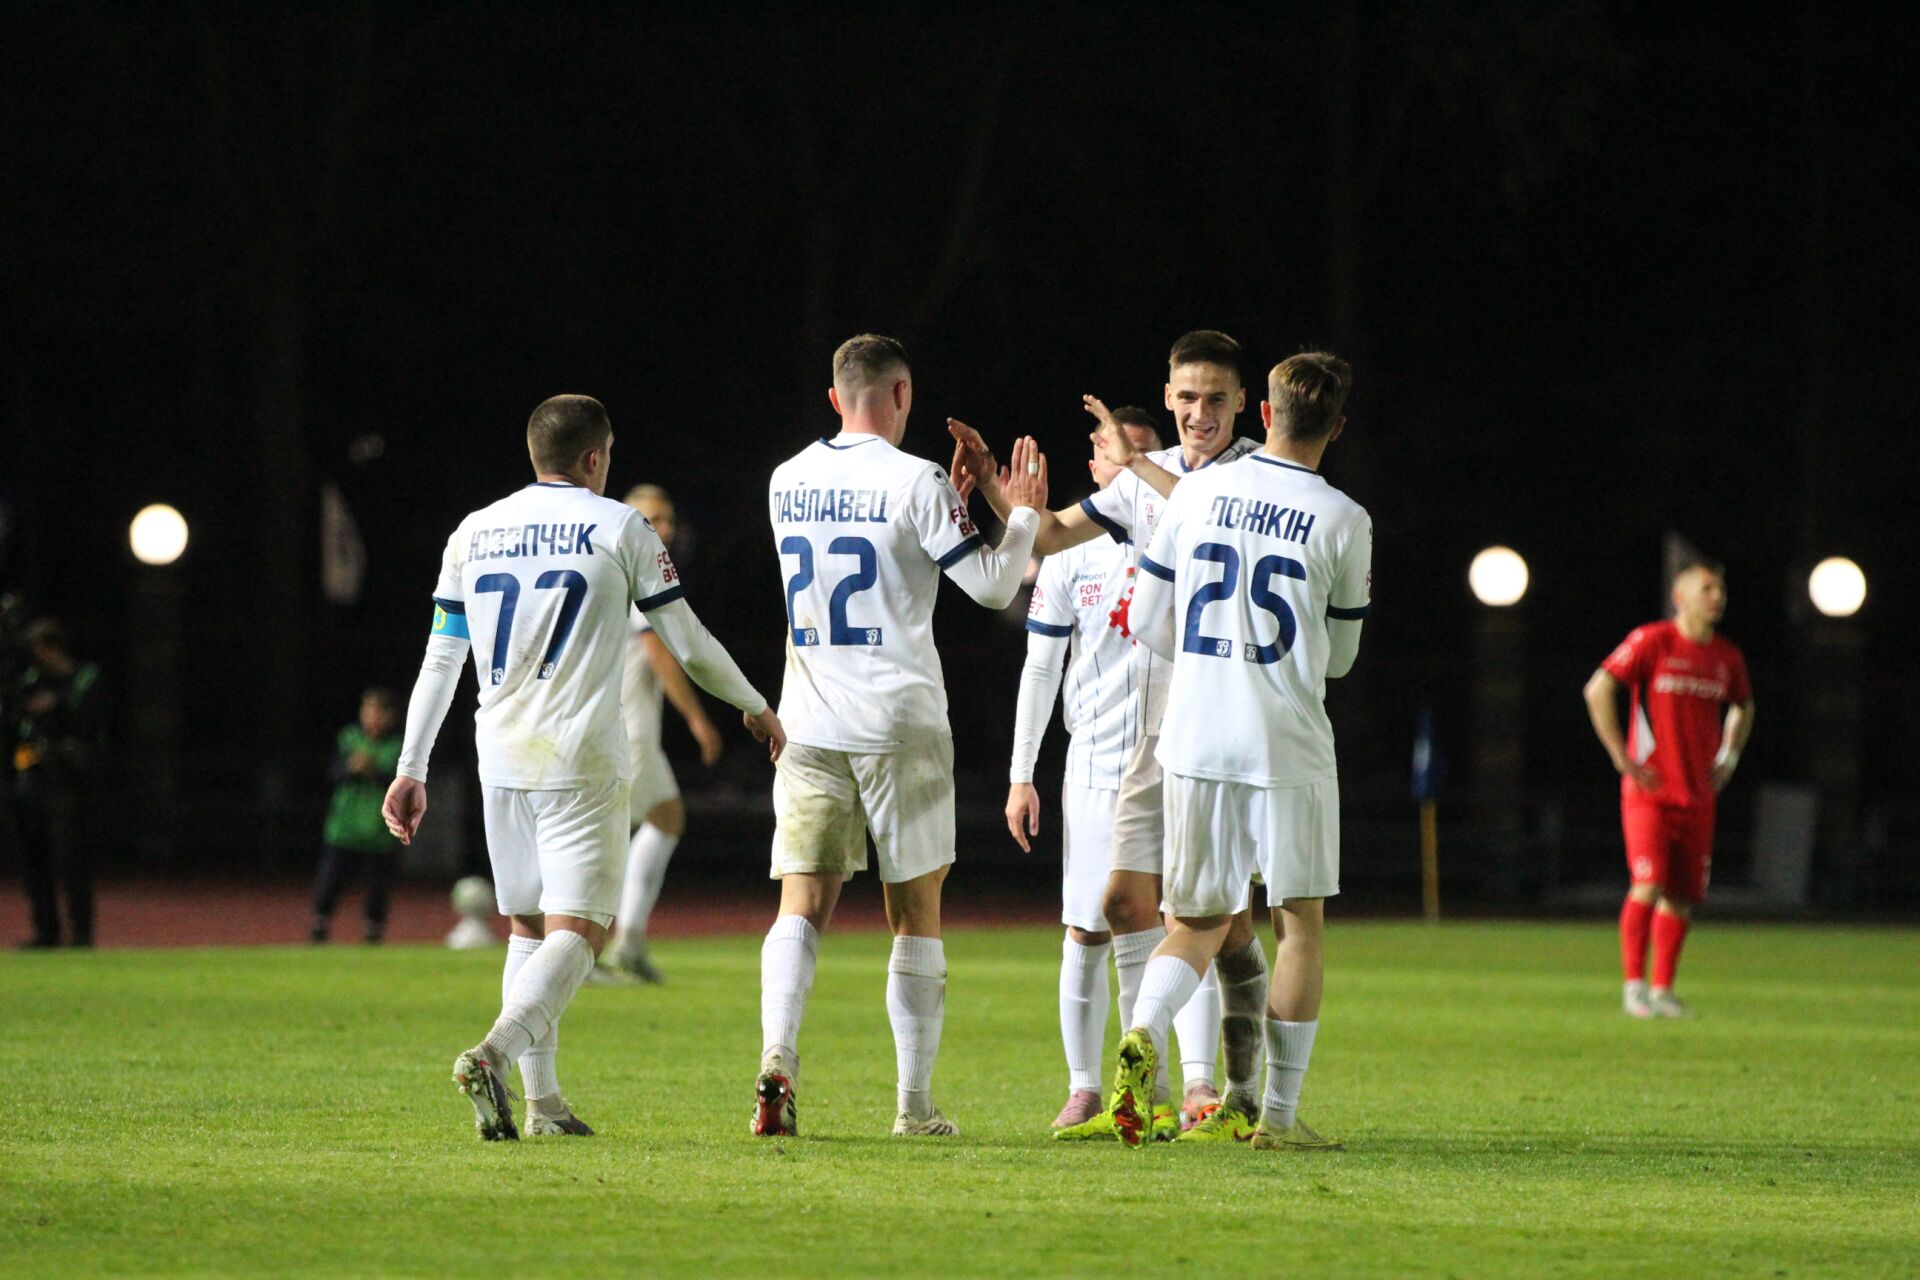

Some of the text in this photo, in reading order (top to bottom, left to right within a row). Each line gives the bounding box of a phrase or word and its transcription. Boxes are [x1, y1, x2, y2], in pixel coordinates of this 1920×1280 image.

[774, 482, 888, 523] ПАЎЛАВЕЦ
[950, 505, 967, 525] FO
[959, 520, 976, 537] BE
[656, 551, 672, 568] FO
[663, 567, 678, 584] BE
[780, 536, 883, 646] 22
[1032, 585, 1044, 601] ON
[1080, 583, 1102, 596] FON
[1028, 601, 1045, 616] ET
[1081, 595, 1103, 607] BET
[1183, 542, 1307, 665] 25
[475, 569, 588, 686] 77
